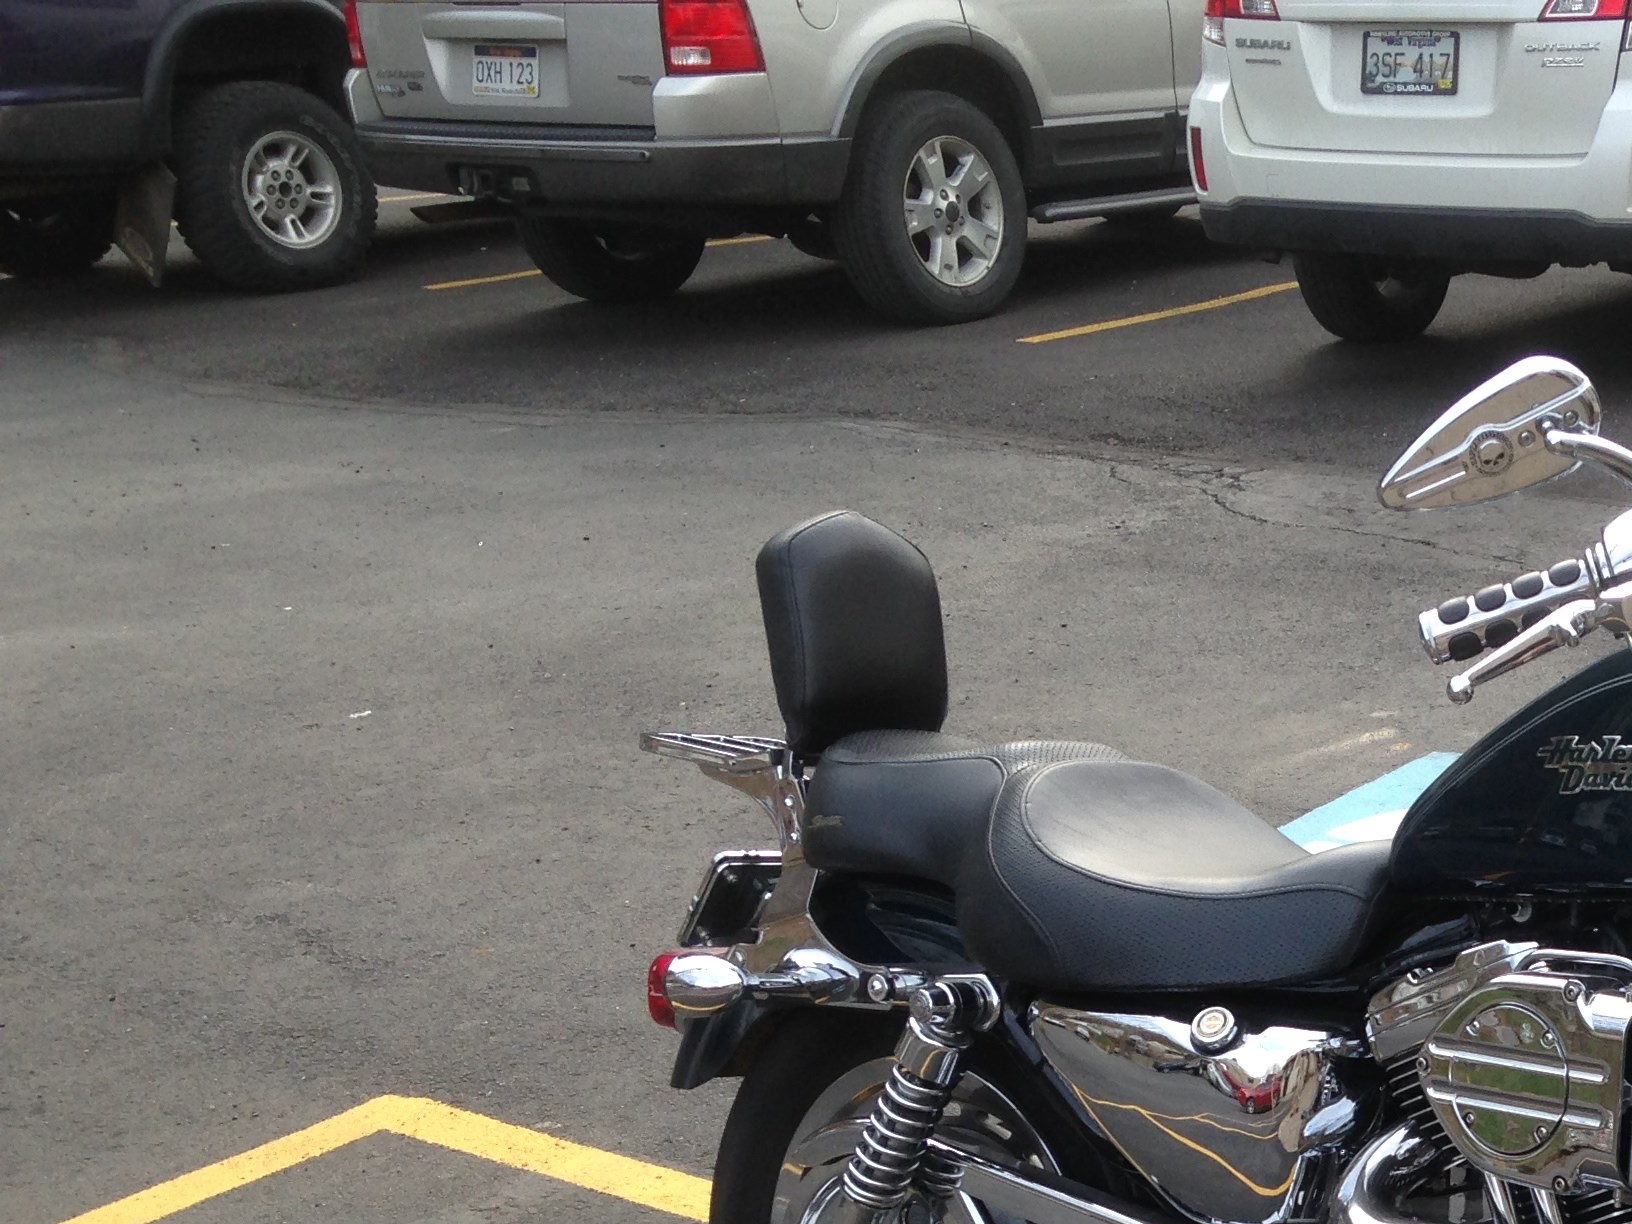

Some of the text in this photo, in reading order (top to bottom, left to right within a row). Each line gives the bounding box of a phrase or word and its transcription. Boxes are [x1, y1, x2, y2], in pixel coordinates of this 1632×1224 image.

[1235, 38, 1291, 50] SUBARU
[509, 61, 534, 84] 123
[1369, 52, 1450, 79] 3SF 417
